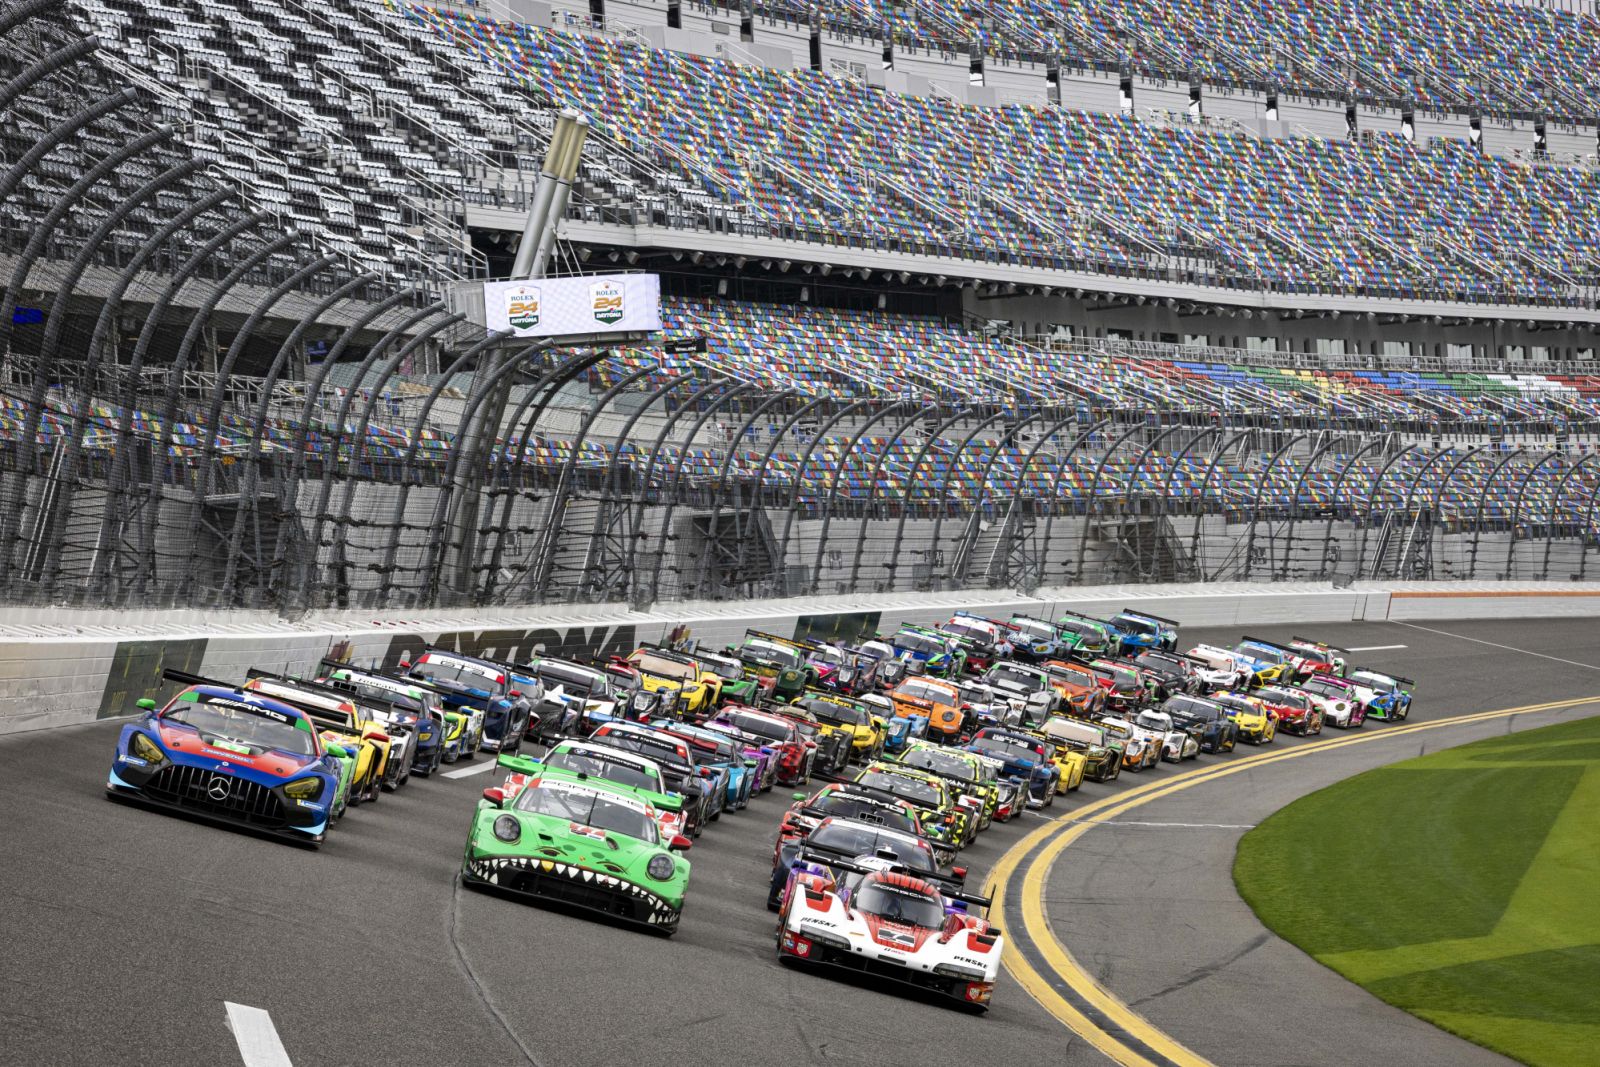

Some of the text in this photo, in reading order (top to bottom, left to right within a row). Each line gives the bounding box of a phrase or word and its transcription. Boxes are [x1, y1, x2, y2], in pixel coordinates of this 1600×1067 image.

[508, 301, 538, 314] 24
[593, 296, 622, 309] 24
[511, 316, 537, 324] DAYTONA
[233, 701, 288, 723] AMG
[603, 755, 642, 770] Motorsport
[541, 780, 644, 811] PORSCHE
[859, 797, 906, 814] AMG
[872, 883, 935, 902] PORSCHE
[801, 916, 838, 928] PENSKE
[953, 955, 988, 969] PENSKE
